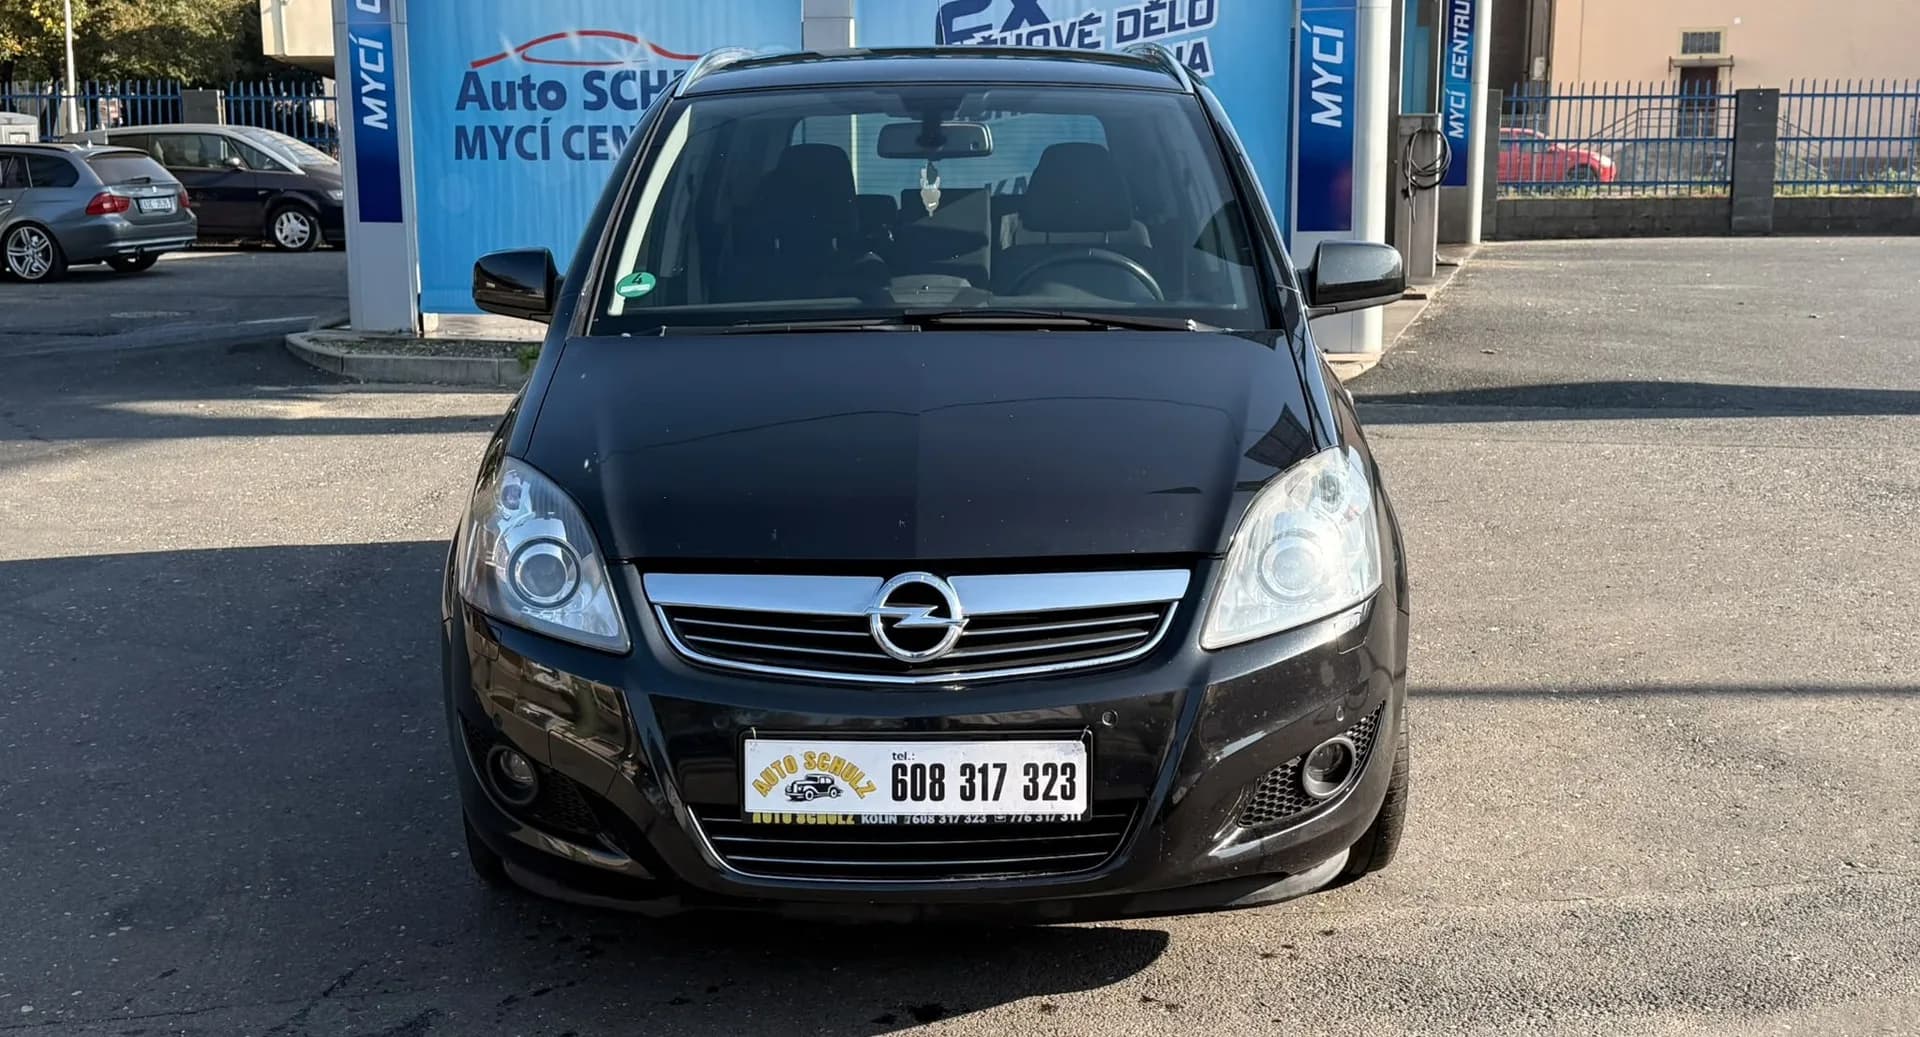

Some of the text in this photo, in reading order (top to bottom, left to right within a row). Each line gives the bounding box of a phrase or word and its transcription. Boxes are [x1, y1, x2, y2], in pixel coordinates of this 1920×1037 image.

[1116, 0, 1208, 43] DĚLO
[349, 32, 388, 130] MYCÍ
[455, 70, 685, 111] Auto SCH
[1301, 20, 1344, 128] MYCÍ
[1445, 89, 1465, 138] MYCÍ
[455, 117, 549, 161] MYCÍ
[752, 751, 877, 799] AUTO SCHULZ
[892, 752, 915, 761] tel.:
[892, 763, 1076, 801] 608 317 323
[912, 815, 935, 824] 608
